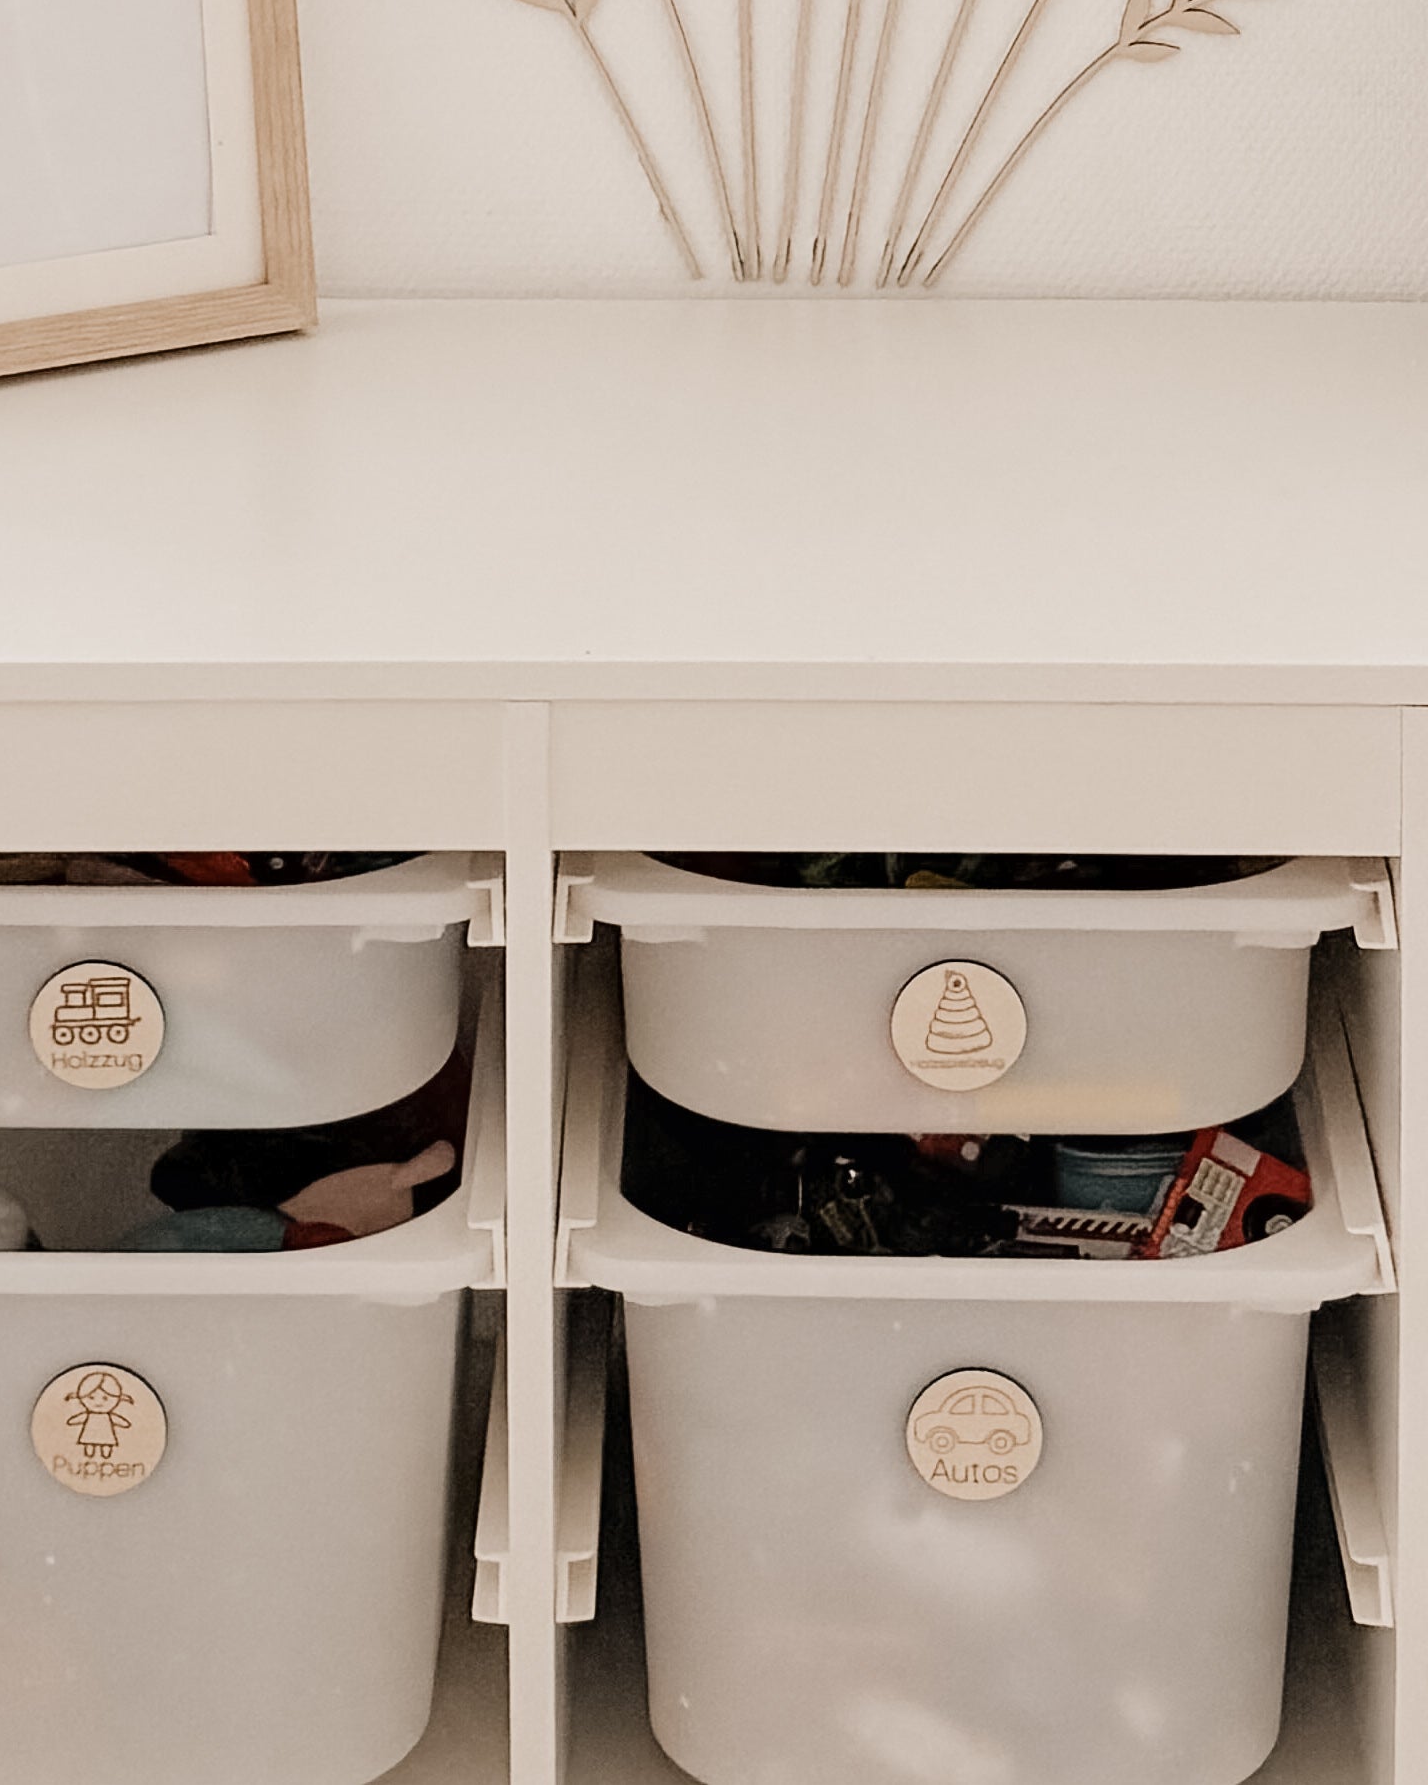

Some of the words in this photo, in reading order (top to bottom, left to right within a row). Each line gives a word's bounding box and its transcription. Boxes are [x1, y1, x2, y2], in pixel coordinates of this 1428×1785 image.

[51, 1050, 143, 1072] Holzzug
[52, 1454, 146, 1481] Puppen
[930, 1458, 1019, 1484] Autos
